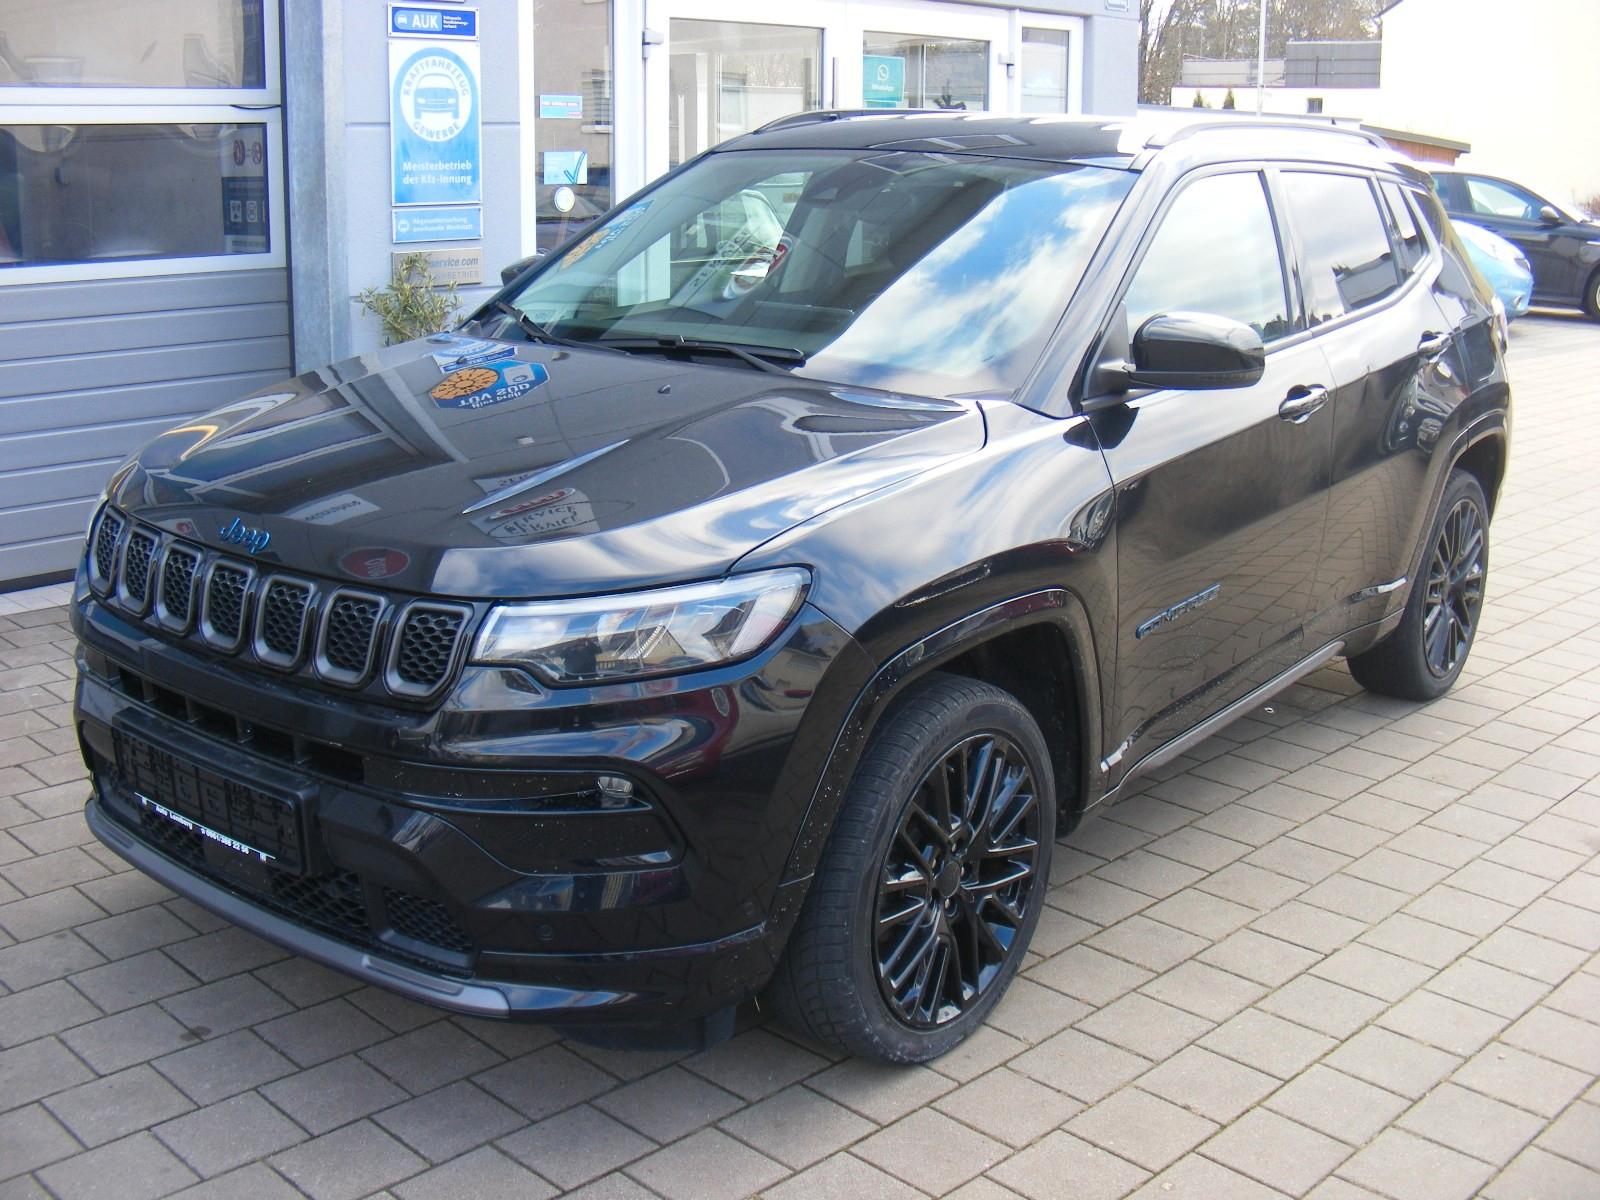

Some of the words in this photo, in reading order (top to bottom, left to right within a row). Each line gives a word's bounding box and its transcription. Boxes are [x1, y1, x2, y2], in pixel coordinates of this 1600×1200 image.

[403, 59, 469, 97] KRAFTFAHRZEUG
[413, 121, 461, 140] GEWERBE
[402, 159, 473, 171] Meisterbetrieb
[403, 174, 418, 185] der
[217, 515, 272, 555] Jeep
